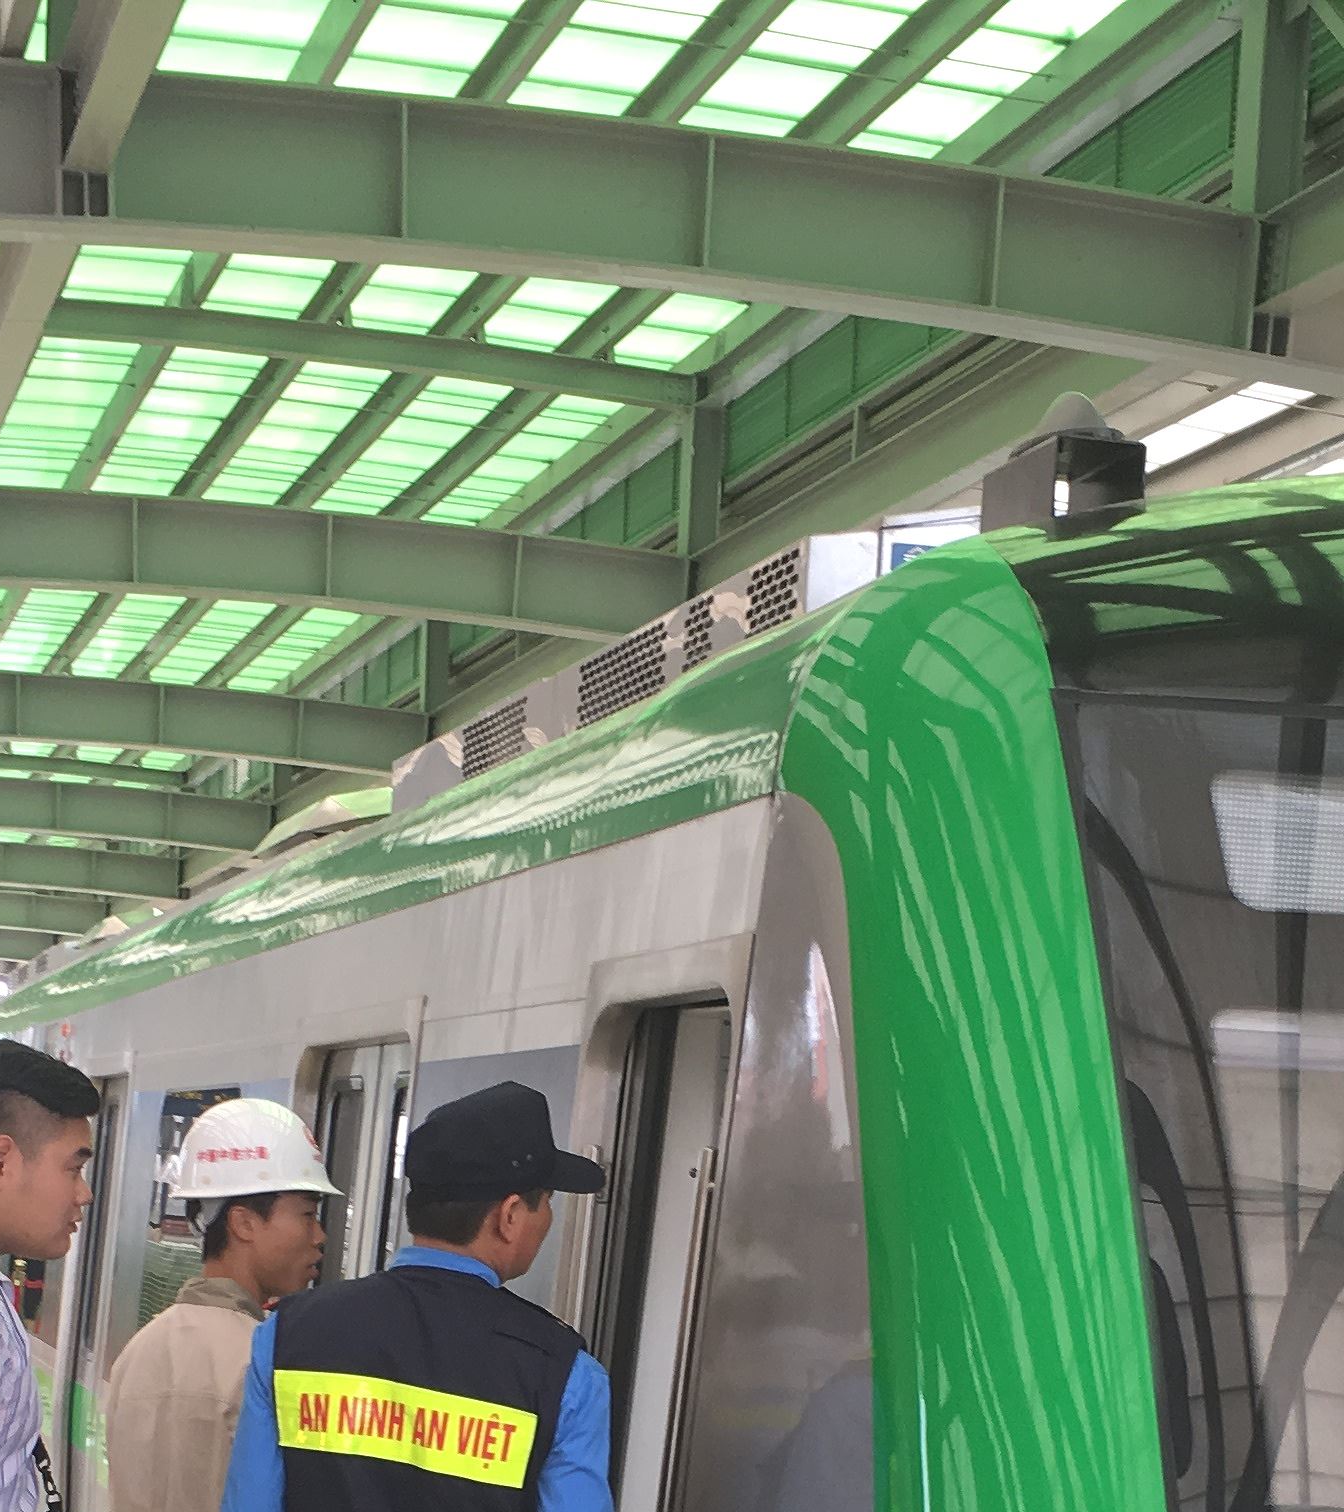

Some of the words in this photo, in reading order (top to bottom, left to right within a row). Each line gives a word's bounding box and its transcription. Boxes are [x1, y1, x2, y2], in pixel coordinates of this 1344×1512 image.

[299, 1393, 330, 1433] AN
[338, 1396, 405, 1442] NINH
[411, 1408, 449, 1451] AN
[457, 1413, 517, 1469] VIỆT
